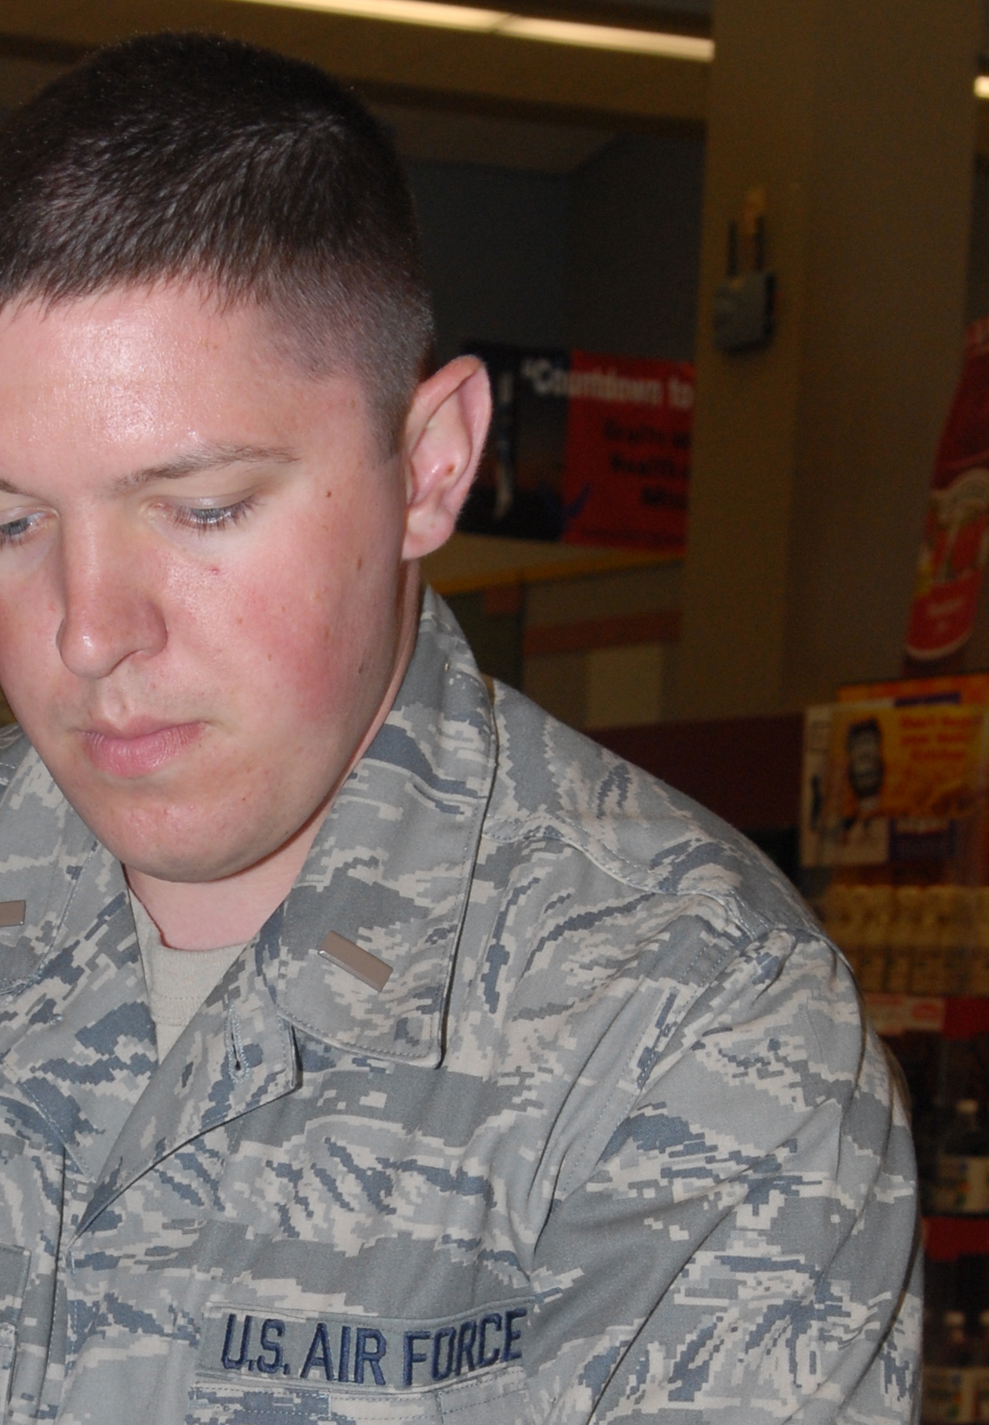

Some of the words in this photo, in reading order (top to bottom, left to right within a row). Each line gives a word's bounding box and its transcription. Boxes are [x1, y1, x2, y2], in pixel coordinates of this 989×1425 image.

[221, 1313, 291, 1375] U.S.
[300, 1322, 387, 1386] AIR
[402, 1307, 527, 1388] FORCE
